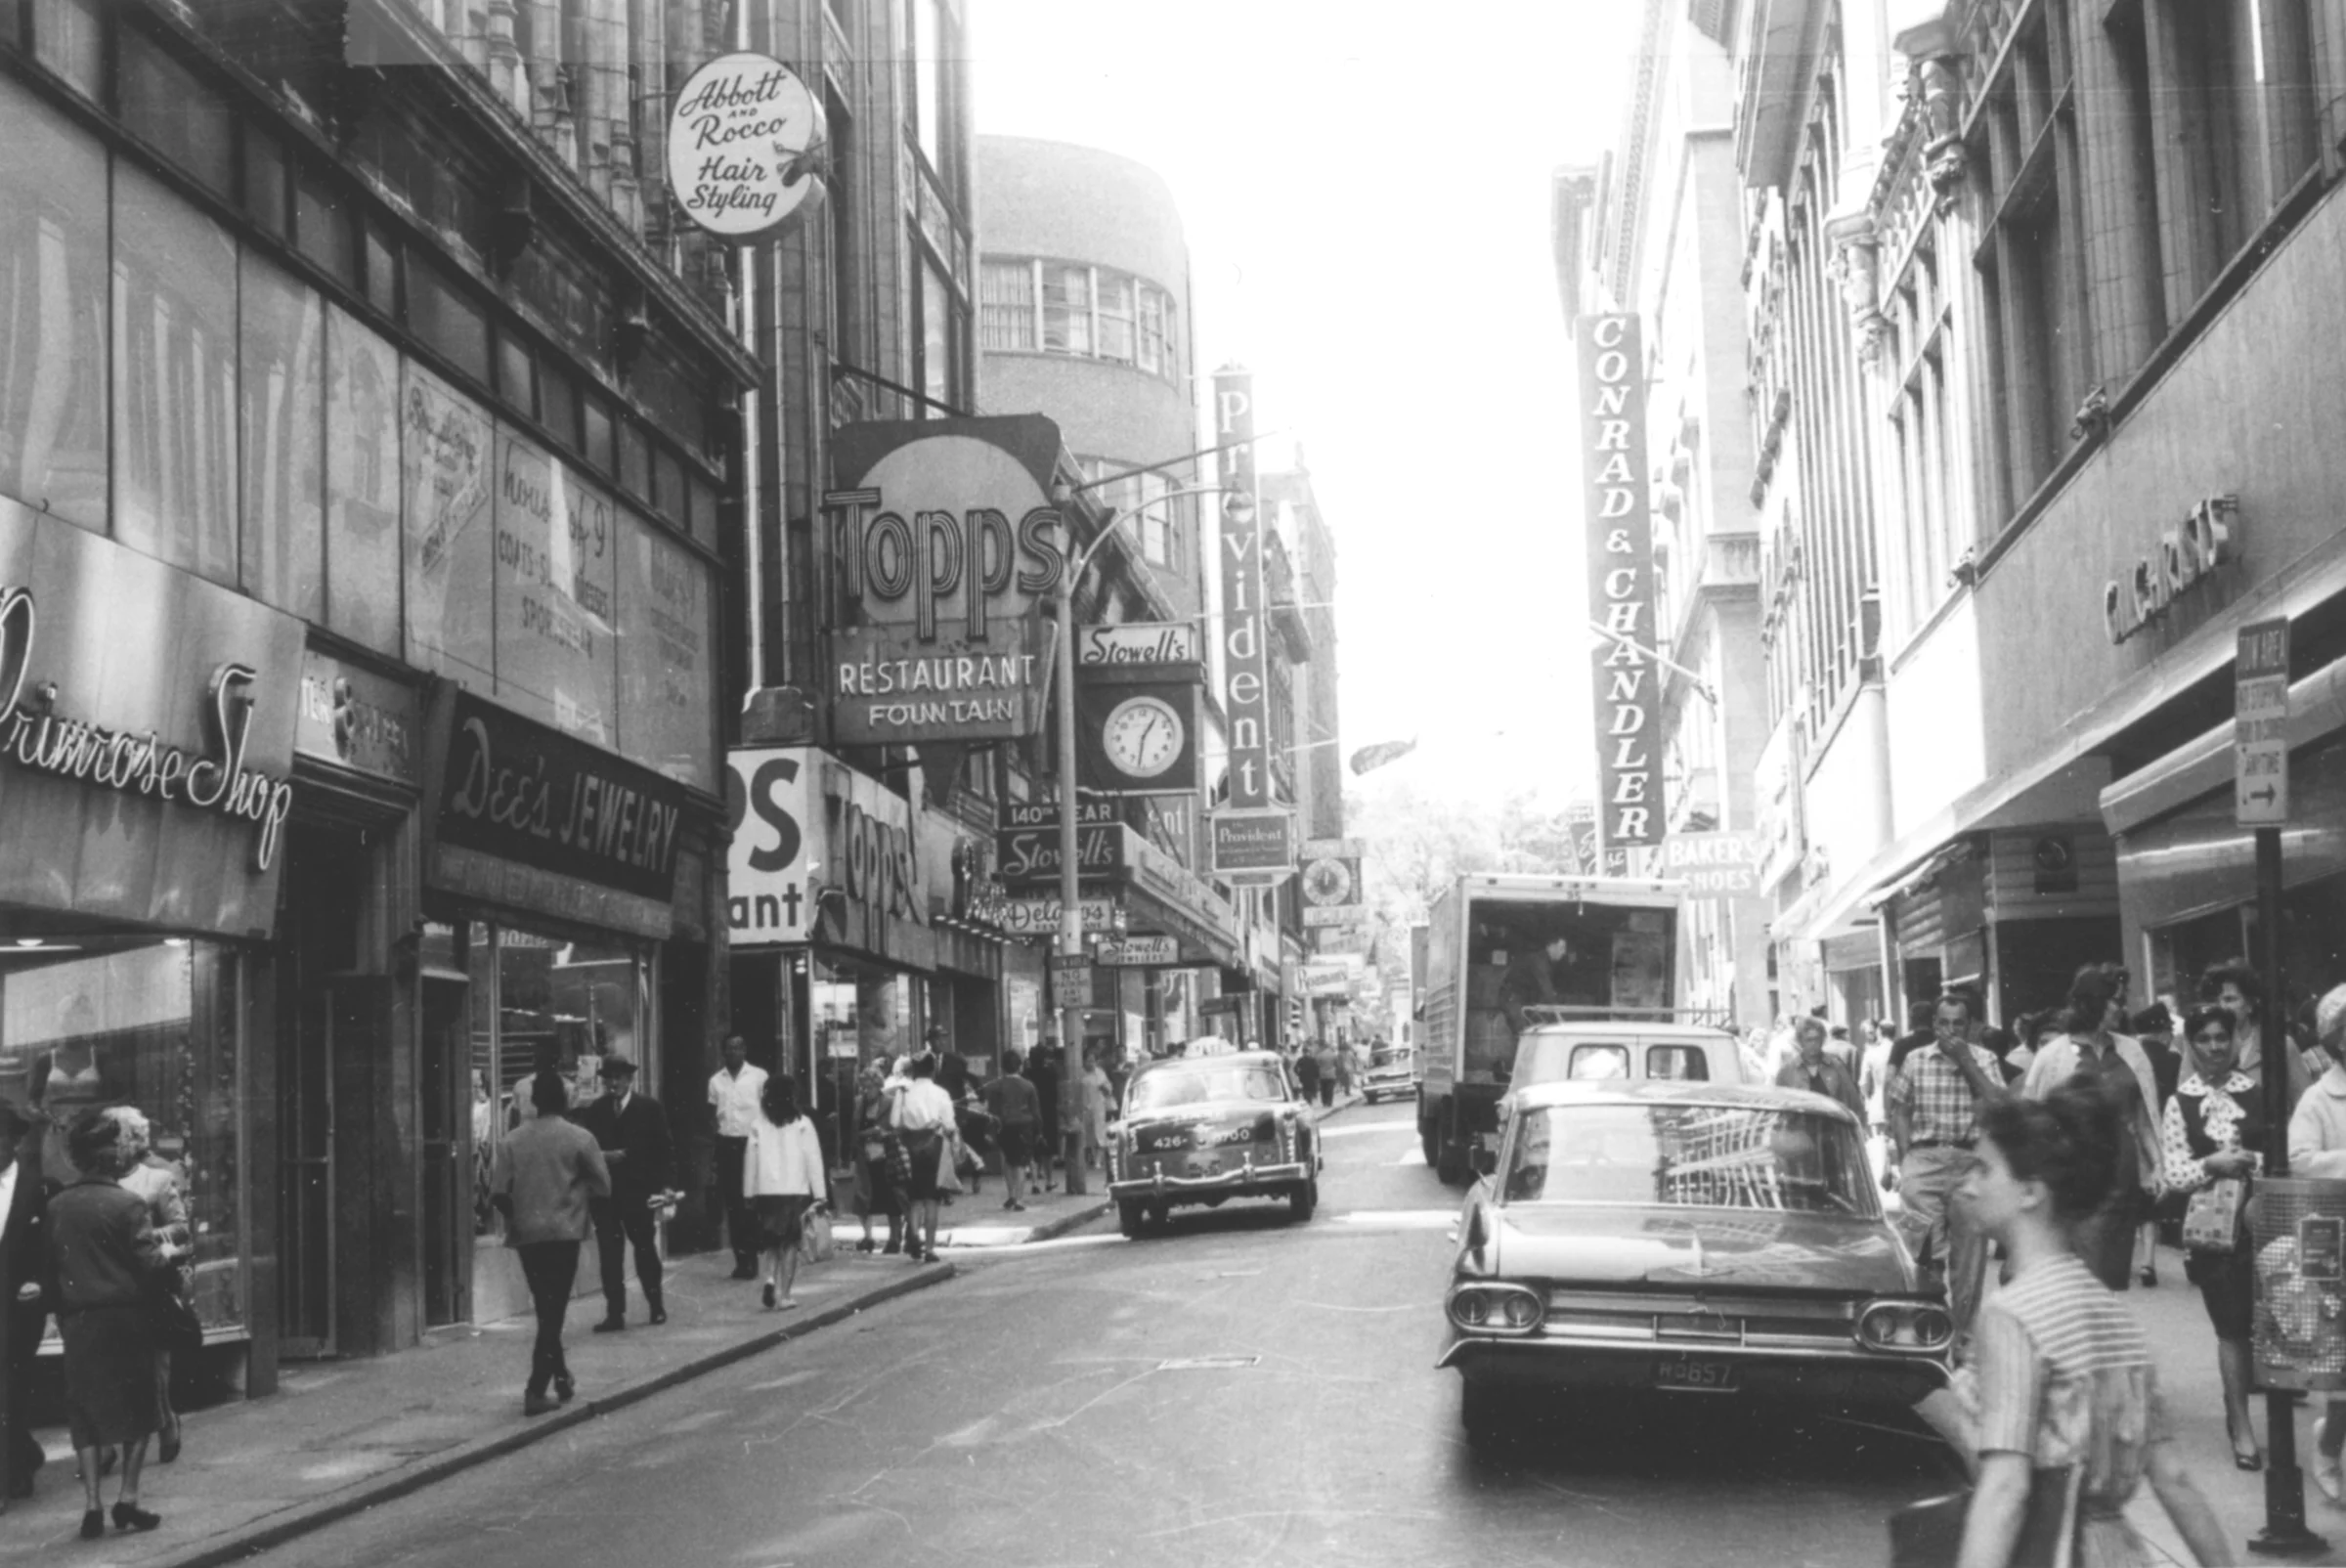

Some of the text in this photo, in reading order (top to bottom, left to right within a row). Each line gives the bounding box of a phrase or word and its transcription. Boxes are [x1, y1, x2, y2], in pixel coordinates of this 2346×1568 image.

[678, 69, 788, 117] Abbott
[728, 108, 758, 118] AND
[690, 113, 788, 151] Rocco
[698, 154, 767, 182] Hair
[686, 183, 778, 218] Styling
[1591, 318, 1634, 517] CONRAD
[1605, 529, 1633, 553] &
[1219, 391, 1261, 796] Provident
[1084, 627, 1186, 664] Stowell's
[840, 654, 1035, 694] RESTAURANT
[869, 698, 1014, 726] FOUNTAIN
[1603, 567, 1649, 838] CHANDLER
[188, 665, 292, 870] Shop
[452, 717, 551, 840] Dee's
[559, 771, 678, 874] JEWELRY
[1058, 804, 1111, 822] EAR
[1669, 838, 1759, 867] BAKERS
[1682, 869, 1753, 892] SHOES
